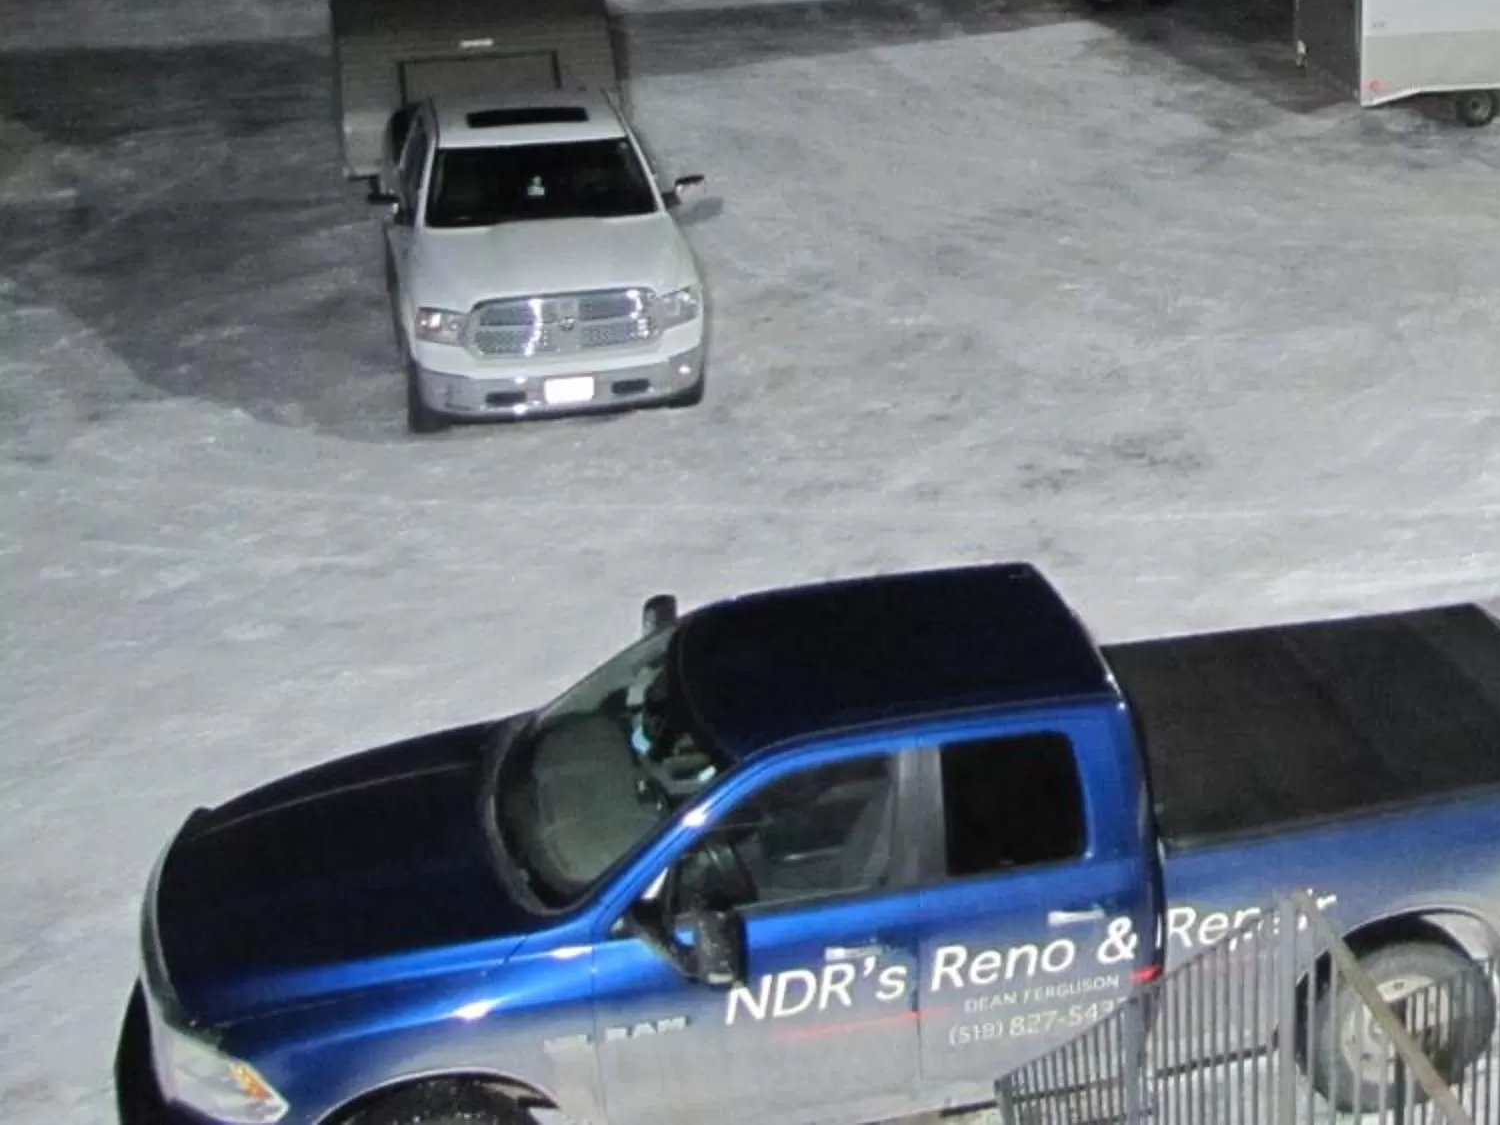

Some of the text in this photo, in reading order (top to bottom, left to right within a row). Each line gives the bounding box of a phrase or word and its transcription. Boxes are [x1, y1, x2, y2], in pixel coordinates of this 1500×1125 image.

[724, 955, 907, 1026] NDR's
[930, 937, 1075, 992] Reno
[1097, 915, 1138, 964] &
[963, 974, 1120, 1013] DEAN FERGUSON
[605, 1015, 687, 1043] RAM
[949, 1020, 1003, 1046] (519)
